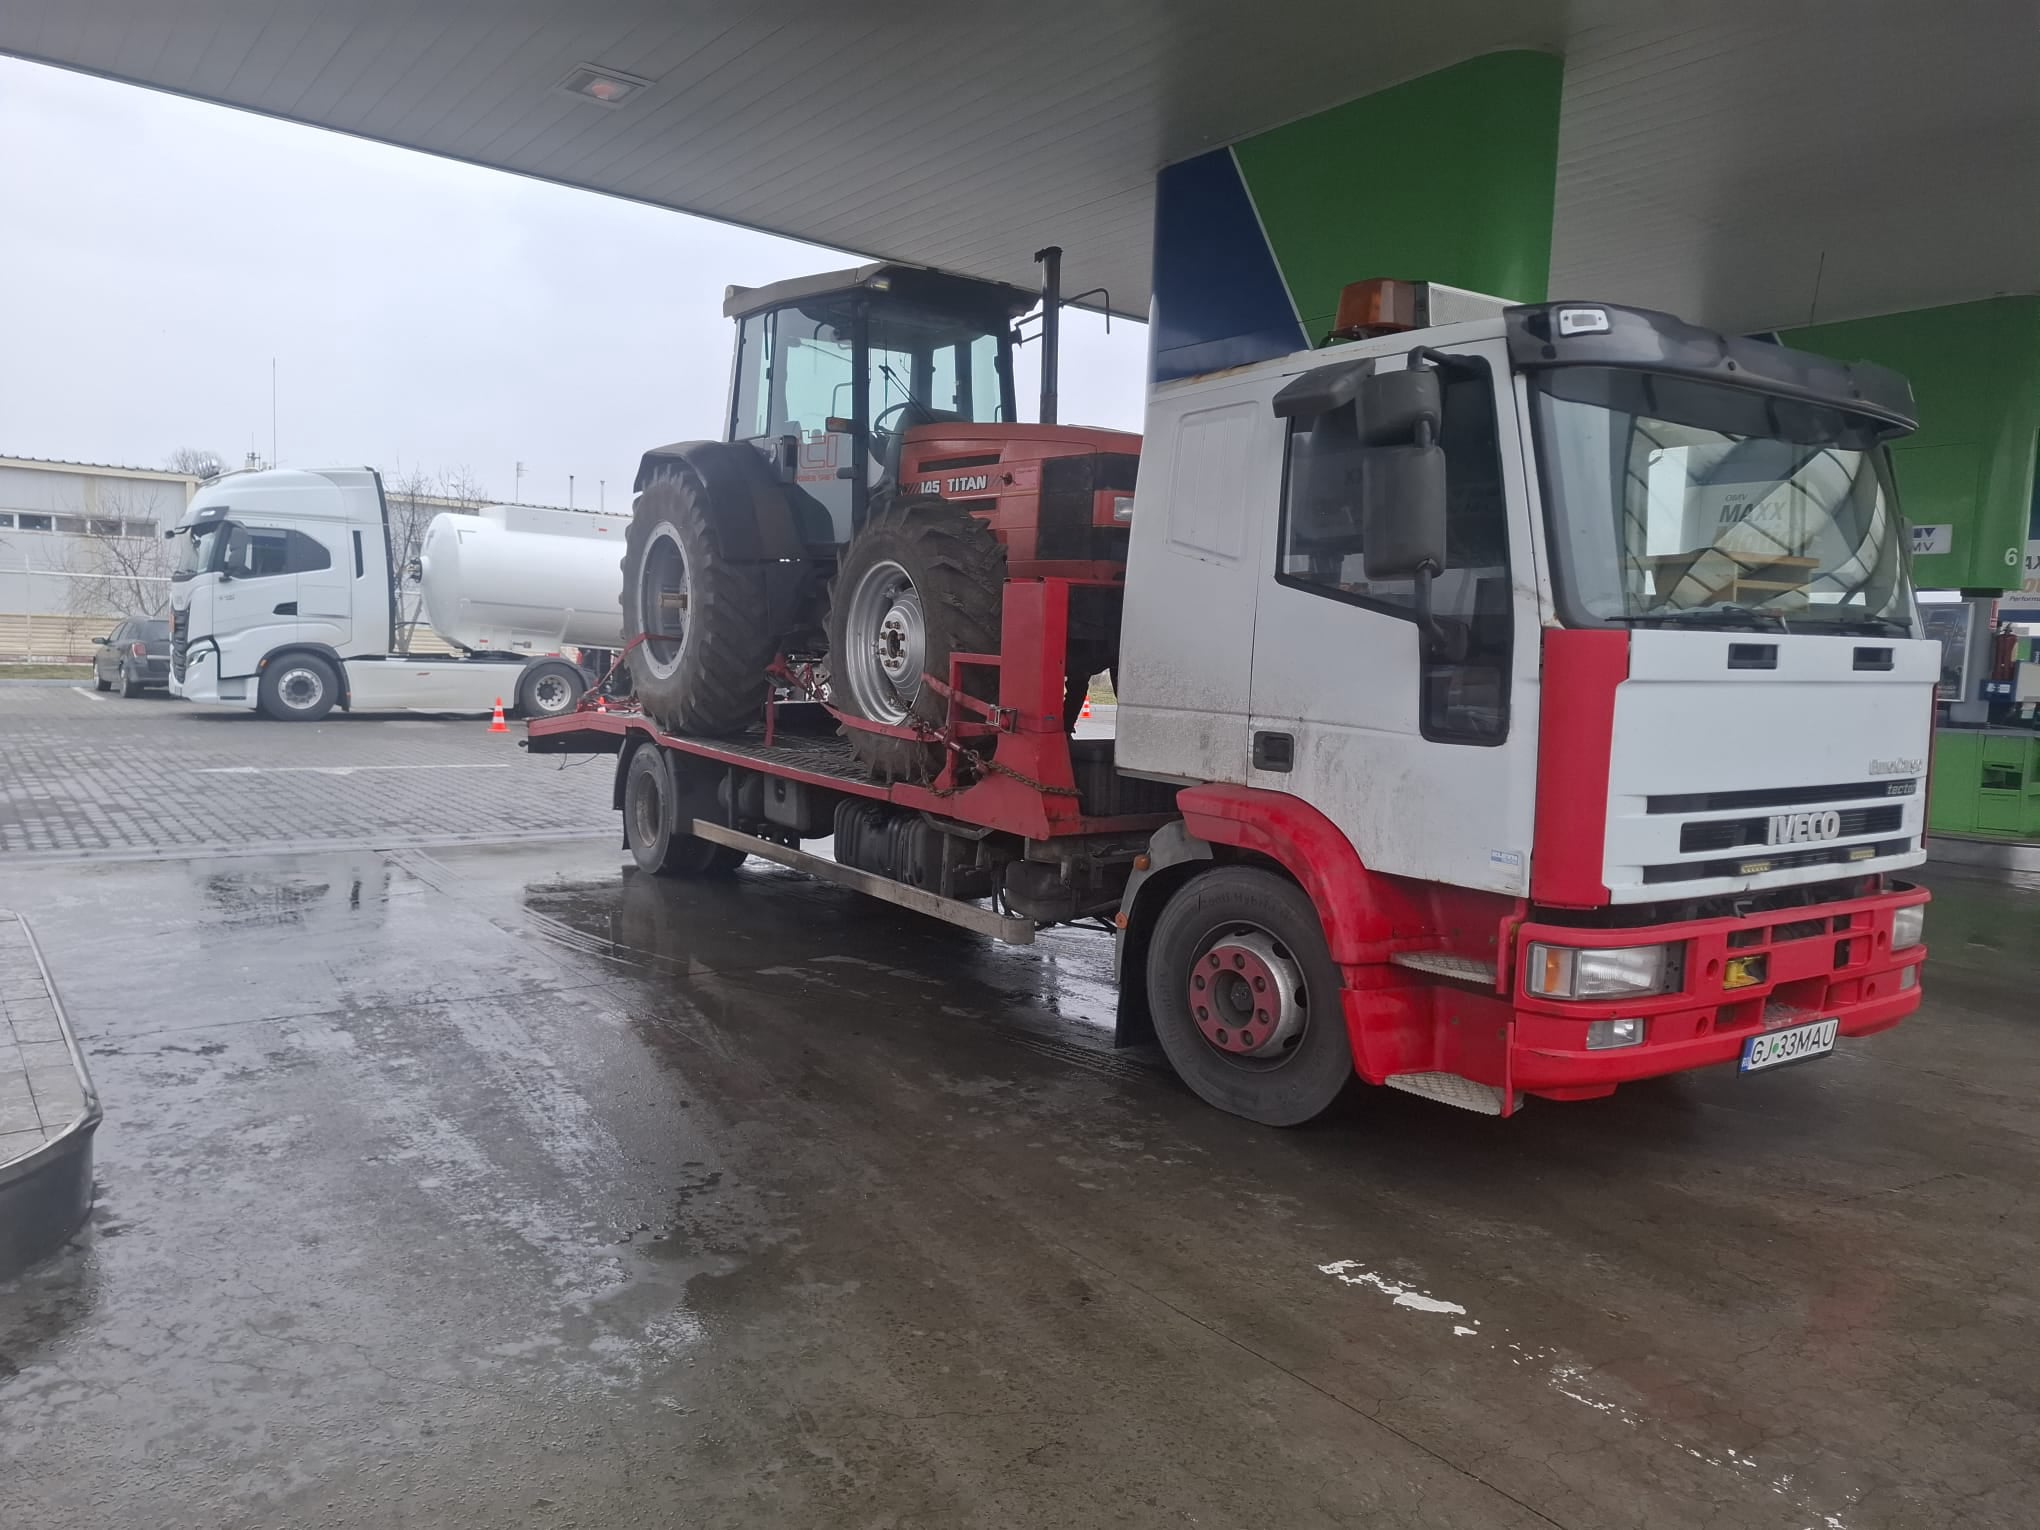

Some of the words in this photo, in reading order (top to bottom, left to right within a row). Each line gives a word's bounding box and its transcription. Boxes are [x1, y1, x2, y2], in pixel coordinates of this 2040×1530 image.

[947, 475, 987, 492] TITAN
[1719, 502, 1787, 522] MAXX
[2004, 547, 2018, 566] 6
[1767, 810, 1841, 846] IVECO
